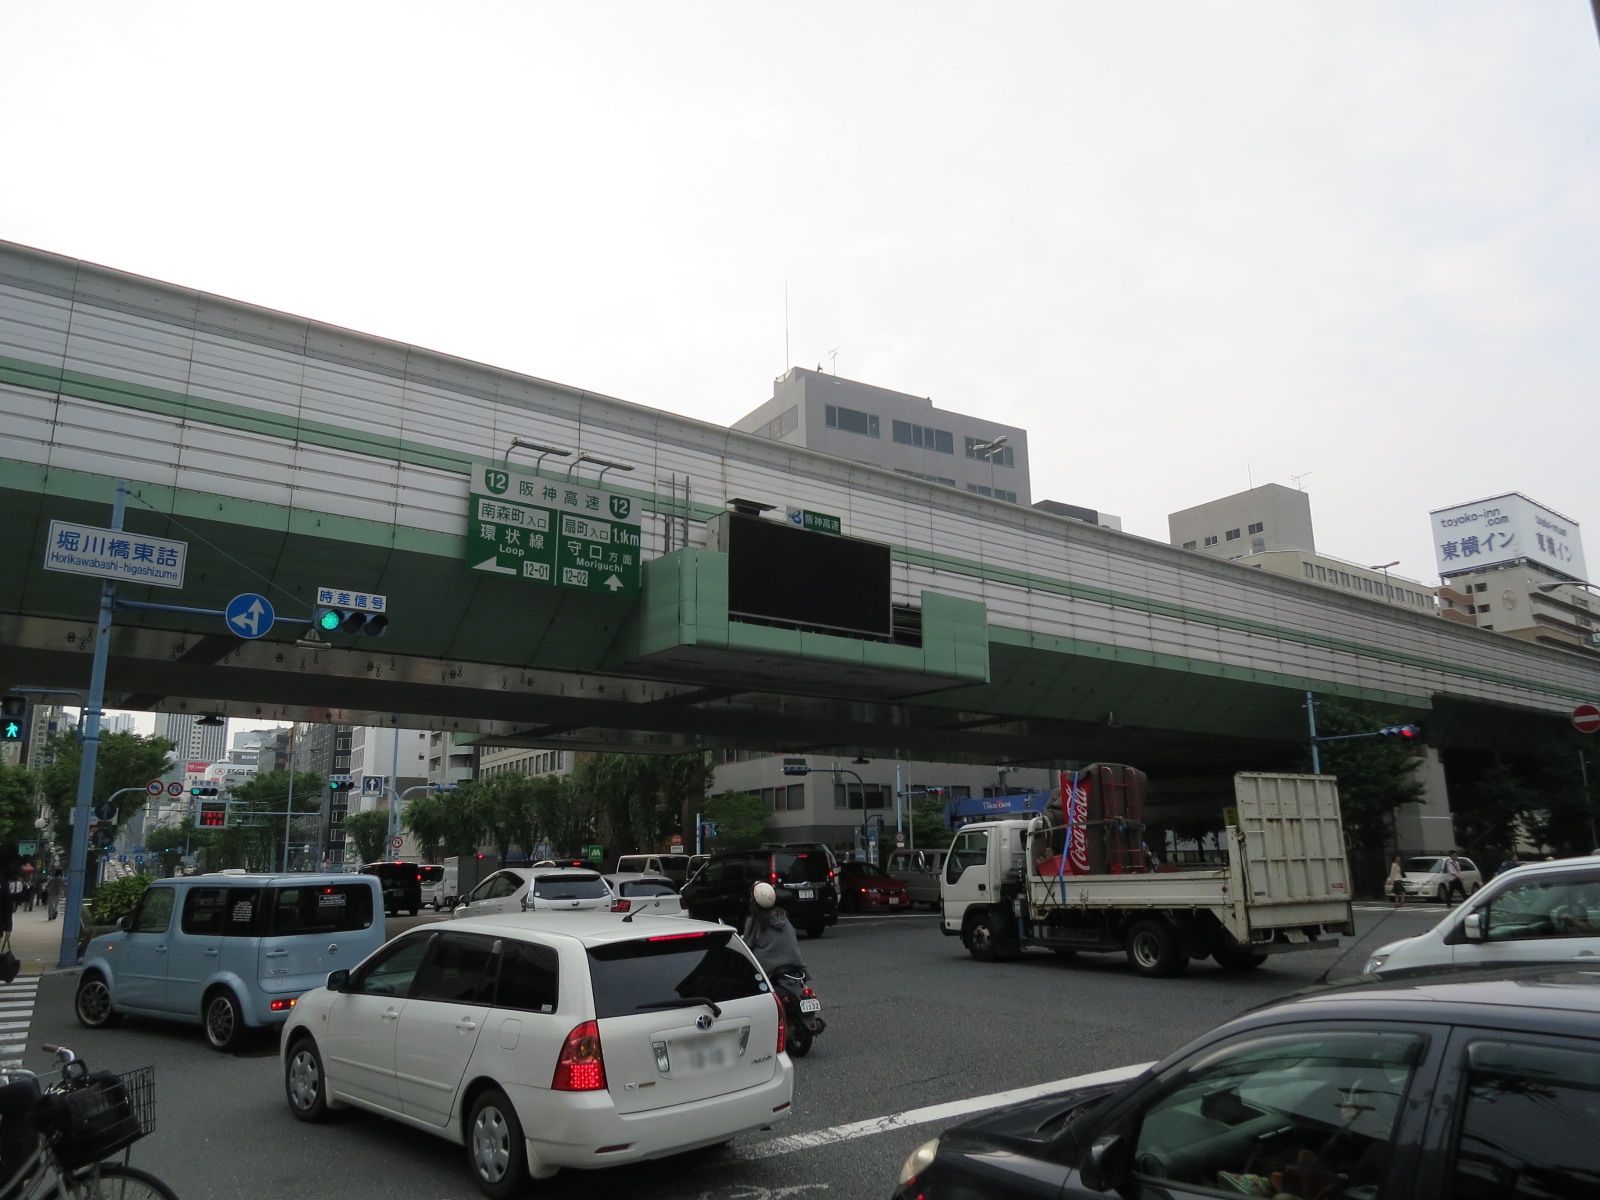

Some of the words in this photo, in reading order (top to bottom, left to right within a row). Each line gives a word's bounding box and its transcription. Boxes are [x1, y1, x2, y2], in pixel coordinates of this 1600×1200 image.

[487, 472, 507, 490] 12
[519, 480, 600, 511] 阪神高速
[611, 498, 628, 515] 12
[481, 503, 547, 529] 南森町入口
[1440, 508, 1500, 528] toyoko-inn
[480, 524, 544, 549] 環状線
[565, 518, 609, 540] 扇町入口
[56, 530, 179, 568] 堀川橋東詰
[499, 544, 525, 557] Loop
[567, 540, 633, 566] 守口方面
[1440, 532, 1516, 562] 東横イン
[51, 551, 178, 580] Horikawabashi-higashizume
[524, 562, 550, 579] 12-01
[576, 556, 623, 573] Moriguchi
[565, 568, 587, 585] 12-02
[319, 590, 384, 610] 時差信号
